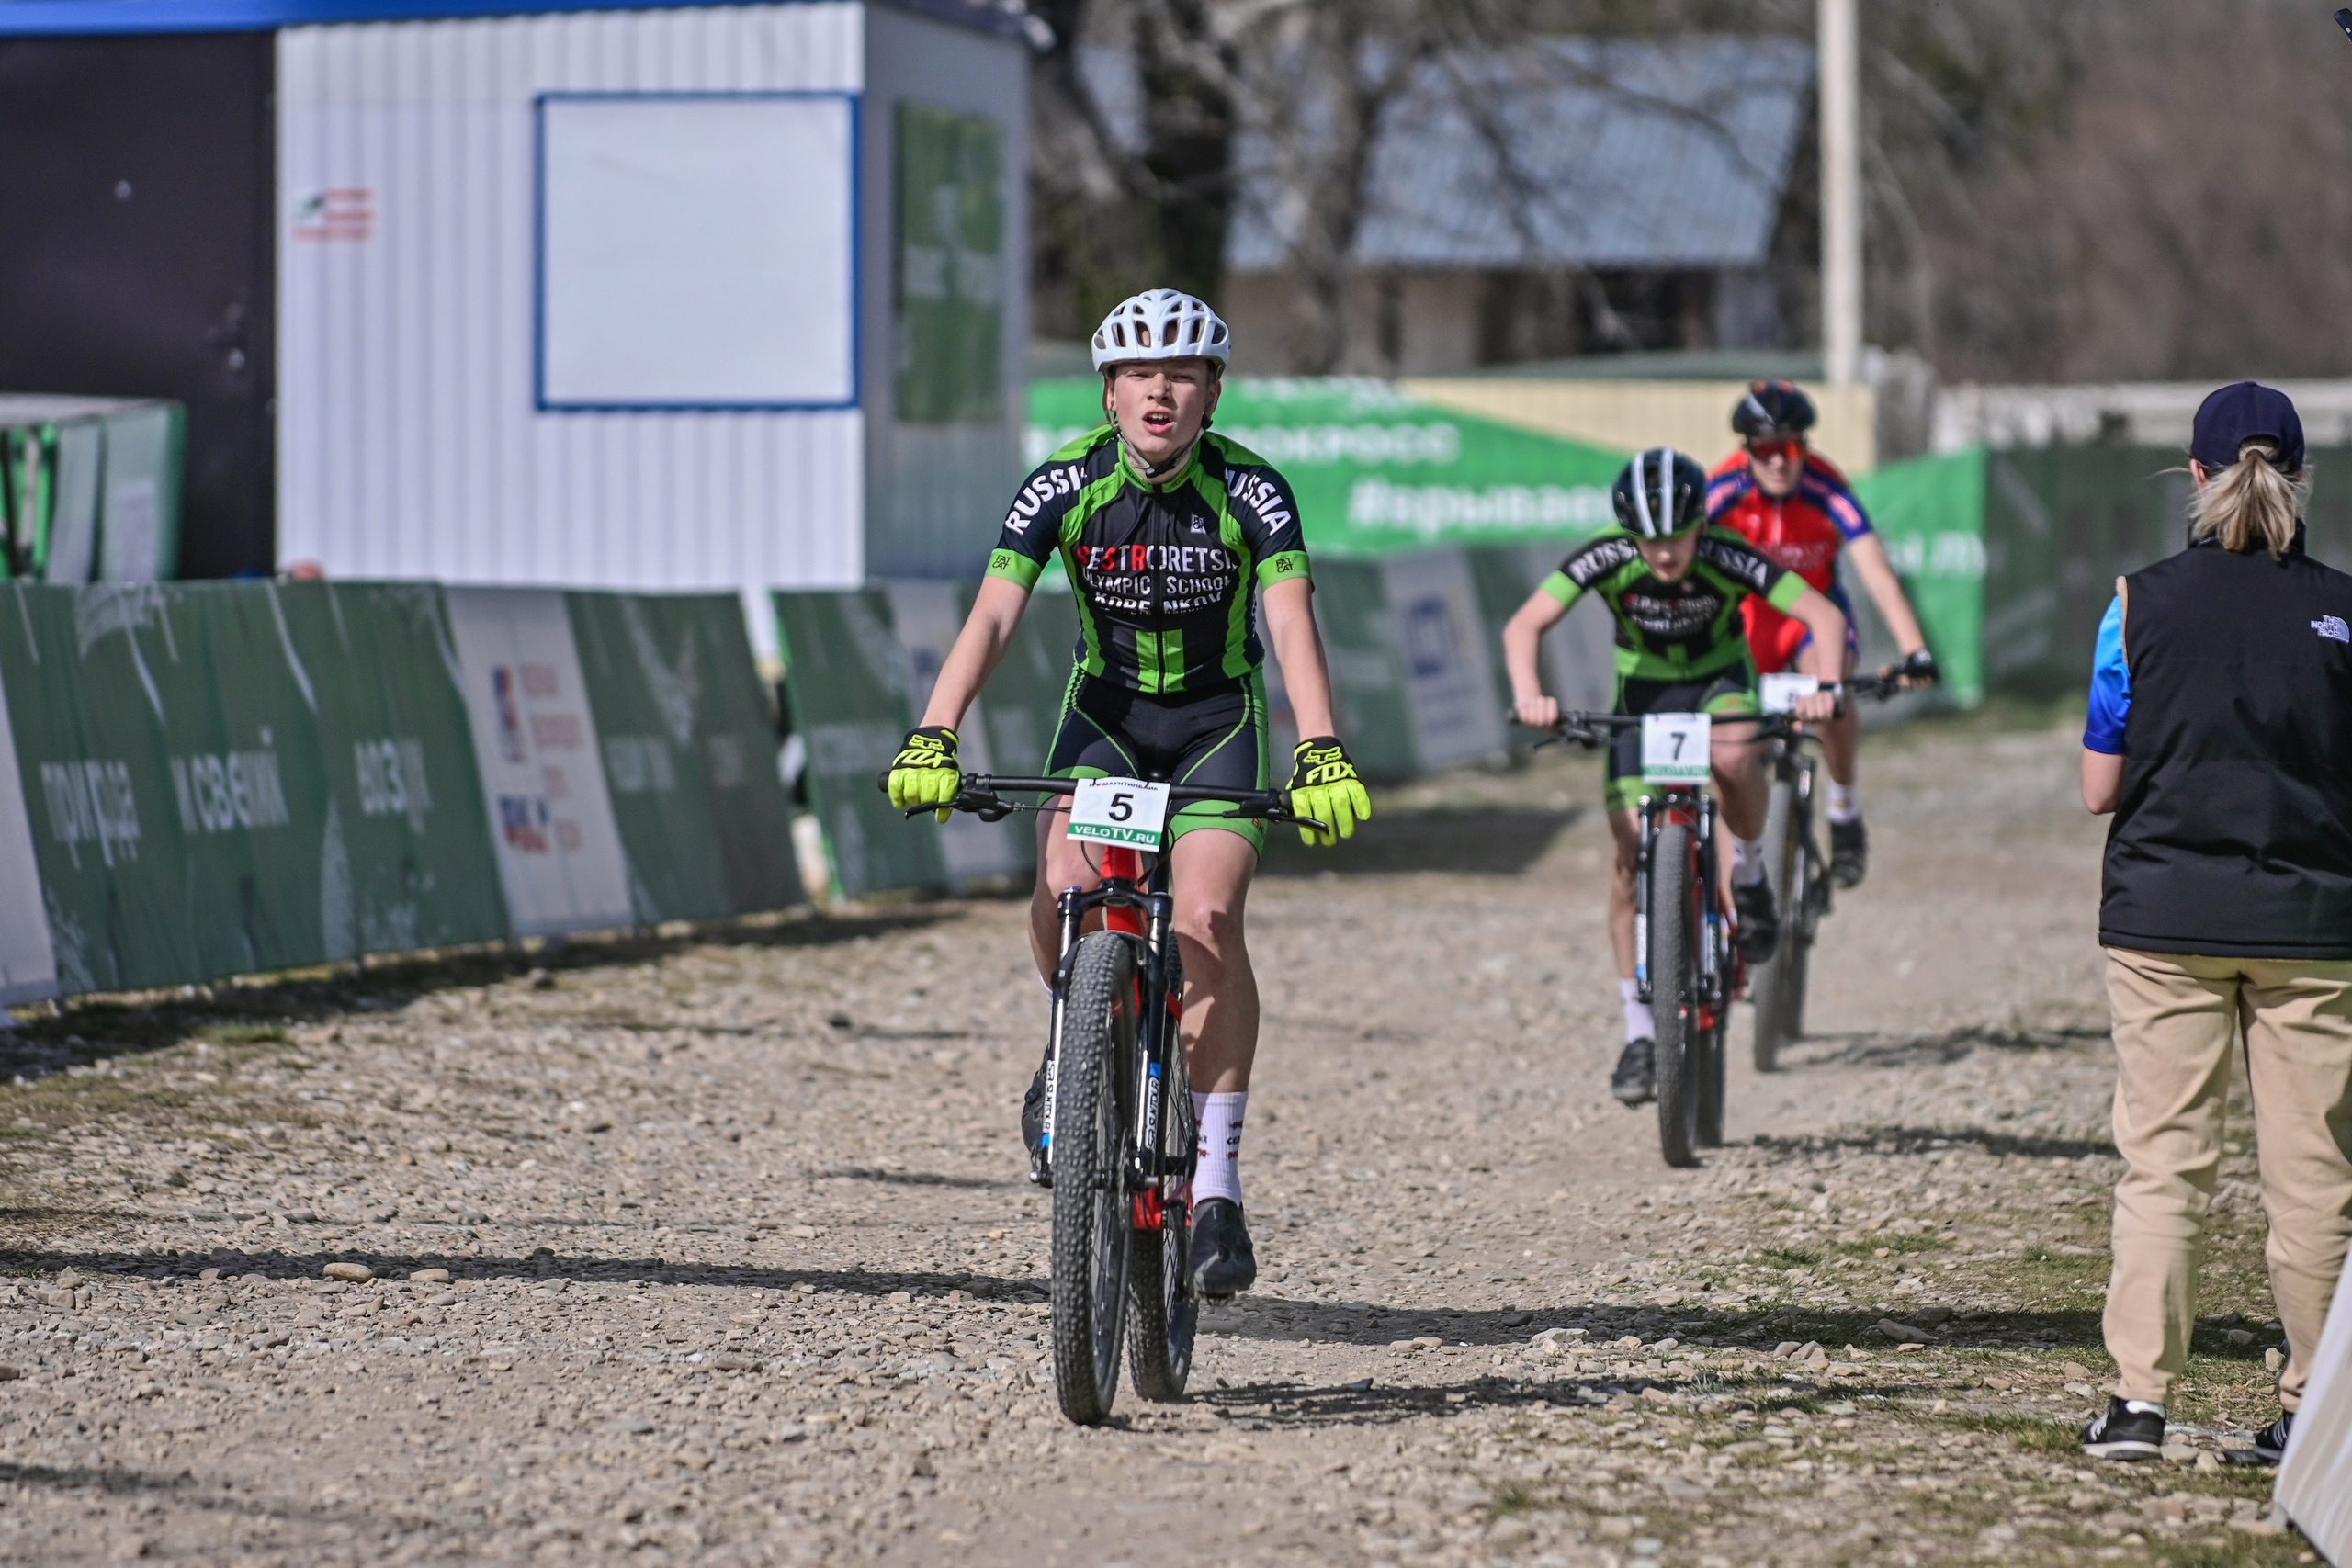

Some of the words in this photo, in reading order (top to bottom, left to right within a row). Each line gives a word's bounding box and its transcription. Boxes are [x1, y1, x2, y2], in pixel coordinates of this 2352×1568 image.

[1225, 467, 1292, 536] USSIA
[996, 554, 1012, 563] FAT
[1670, 732, 1688, 761] 7
[1306, 761, 1358, 784] FOX
[1108, 793, 1134, 822] 5
[1075, 825, 1156, 843] VELOTV.RU
